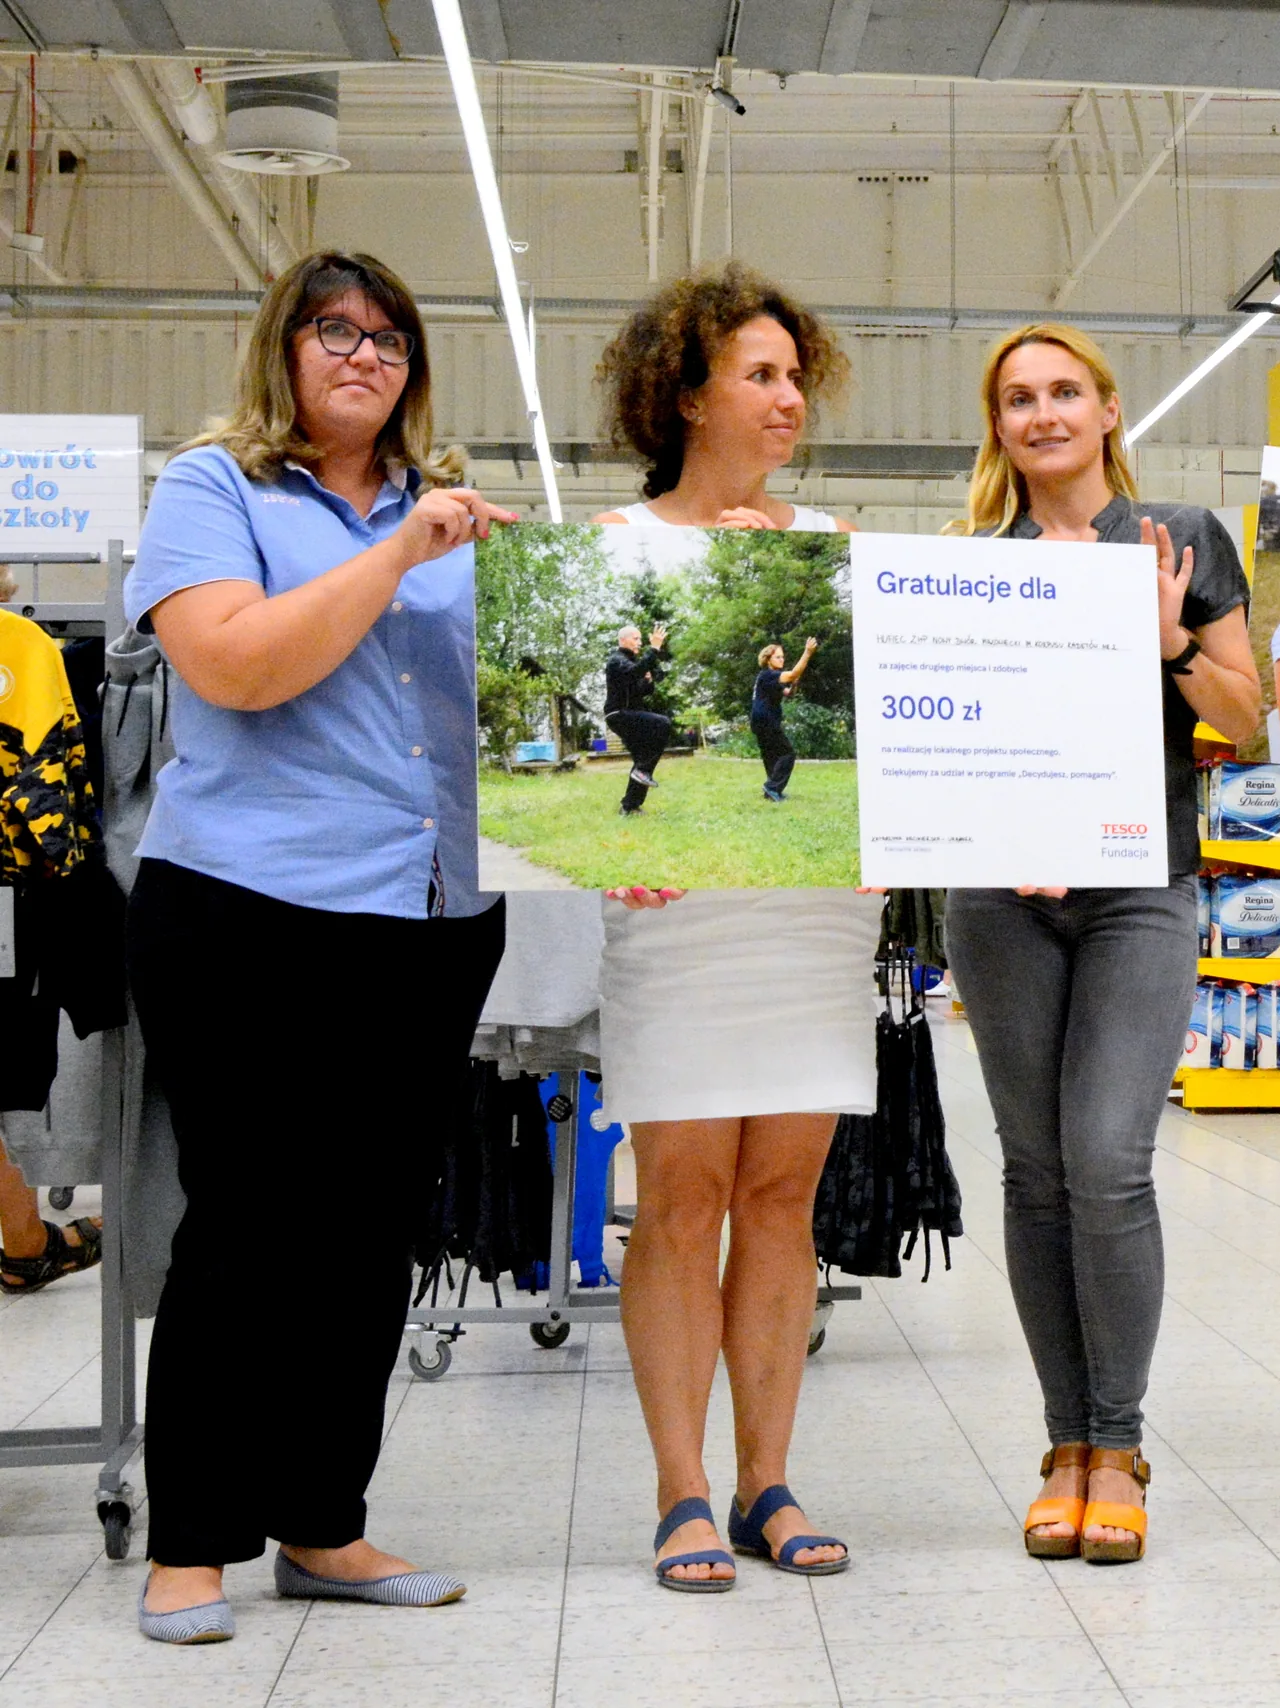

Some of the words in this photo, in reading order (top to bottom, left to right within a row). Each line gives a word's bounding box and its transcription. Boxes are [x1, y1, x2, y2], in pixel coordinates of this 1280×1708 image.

[11, 473, 59, 501] do
[877, 571, 1011, 603] Gratulacje
[1019, 576, 1056, 600] dla
[878, 662, 888, 670] za
[890, 662, 917, 673] zajęcie
[920, 662, 954, 673] drugiego
[956, 663, 986, 674] miejsca
[993, 664, 1028, 675] zdobycie
[882, 695, 954, 720] 3000
[962, 700, 982, 721] zł
[893, 745, 932, 756] realizację
[934, 745, 972, 756] lokalnego
[974, 746, 1007, 757] projektu
[882, 767, 928, 778] Dziękujemy
[930, 769, 939, 777] za
[941, 768, 965, 777] udział
[975, 769, 1016, 779] programie
[1245, 780, 1275, 789] Regina
[1101, 824, 1148, 834] TESCO
[1101, 847, 1149, 860] Fundacja
[1245, 896, 1273, 904] Regina
